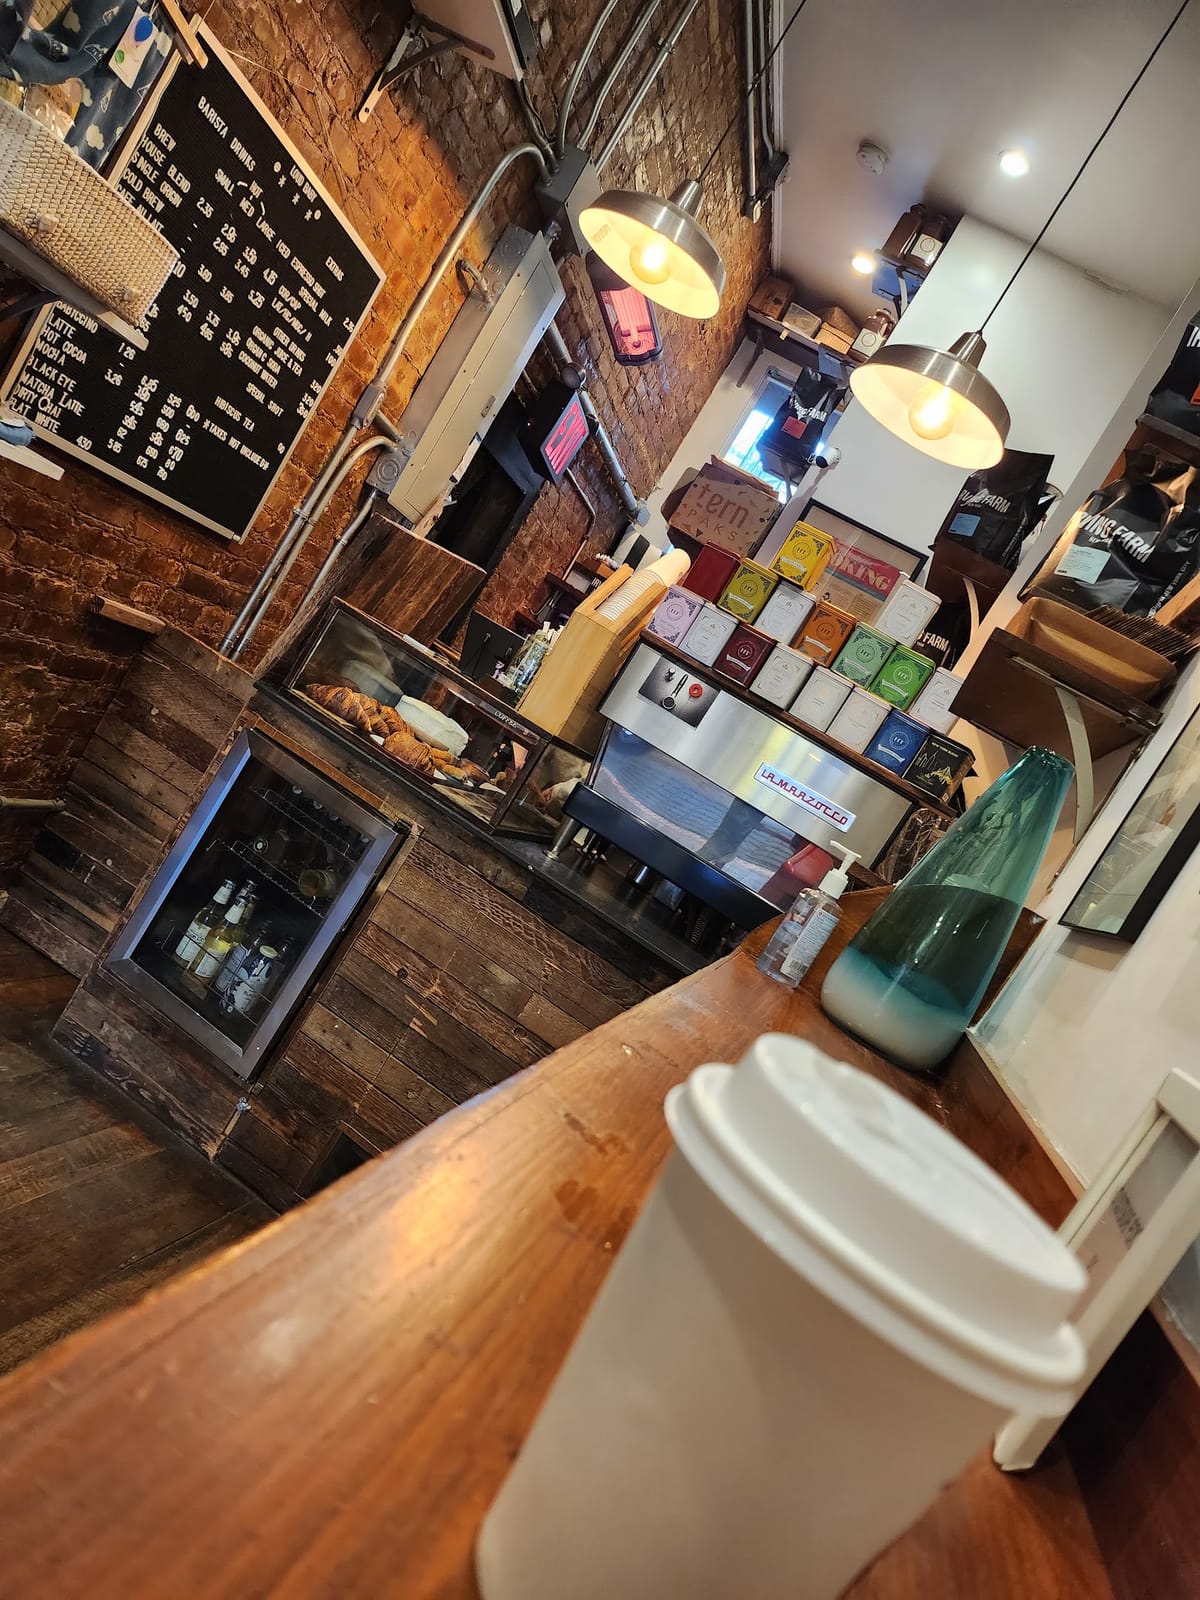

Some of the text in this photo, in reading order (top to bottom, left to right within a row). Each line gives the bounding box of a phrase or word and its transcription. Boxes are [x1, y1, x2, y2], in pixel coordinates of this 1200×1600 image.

[154, 123, 176, 152] BREW
[198, 96, 256, 171] BARISTA DRINKS
[123, 168, 143, 192] COLD
[142, 187, 165, 213] BREW
[132, 151, 159, 183] SINGLE
[160, 181, 183, 208] ORIGIN
[140, 135, 166, 167] HOUSE
[167, 164, 191, 193] BLEND
[197, 197, 214, 218] 2.35
[249, 180, 263, 198] HOT
[290, 165, 318, 203] LOUD BABY
[215, 169, 291, 259] SMALL MED LARGE ICED
[291, 256, 315, 287] ESPRESSO
[313, 282, 326, 299] SHOT
[325, 256, 344, 281] EXTRAS
[298, 286, 333, 327] SPECIAL MILK
[48, 313, 76, 339] LATTE
[273, 327, 290, 347] OTHER
[35, 340, 65, 366] MOCHA
[44, 327, 61, 344] HOT
[62, 341, 87, 364] COCOA
[57, 373, 77, 392] EYE
[238, 351, 263, 374] COCONUT
[260, 369, 278, 389] WATER
[287, 358, 295, 369] &
[292, 362, 303, 377] TEA
[38, 395, 64, 418] CHAI
[58, 392, 85, 416] LATTE
[215, 396, 242, 422] HIBISCUS
[243, 417, 255, 432] TEA
[246, 382, 284, 417] SPECIAL SHOT
[35, 412, 61, 433] WHITE
[76, 436, 92, 450] 430
[228, 437, 241, 450] NOT
[696, 484, 749, 528] tern
[982, 494, 1011, 513] FARM
[687, 509, 738, 541] PAKS
[1112, 525, 1156, 563] FARM
[922, 632, 950, 651] FARM
[761, 769, 778, 786] LA
